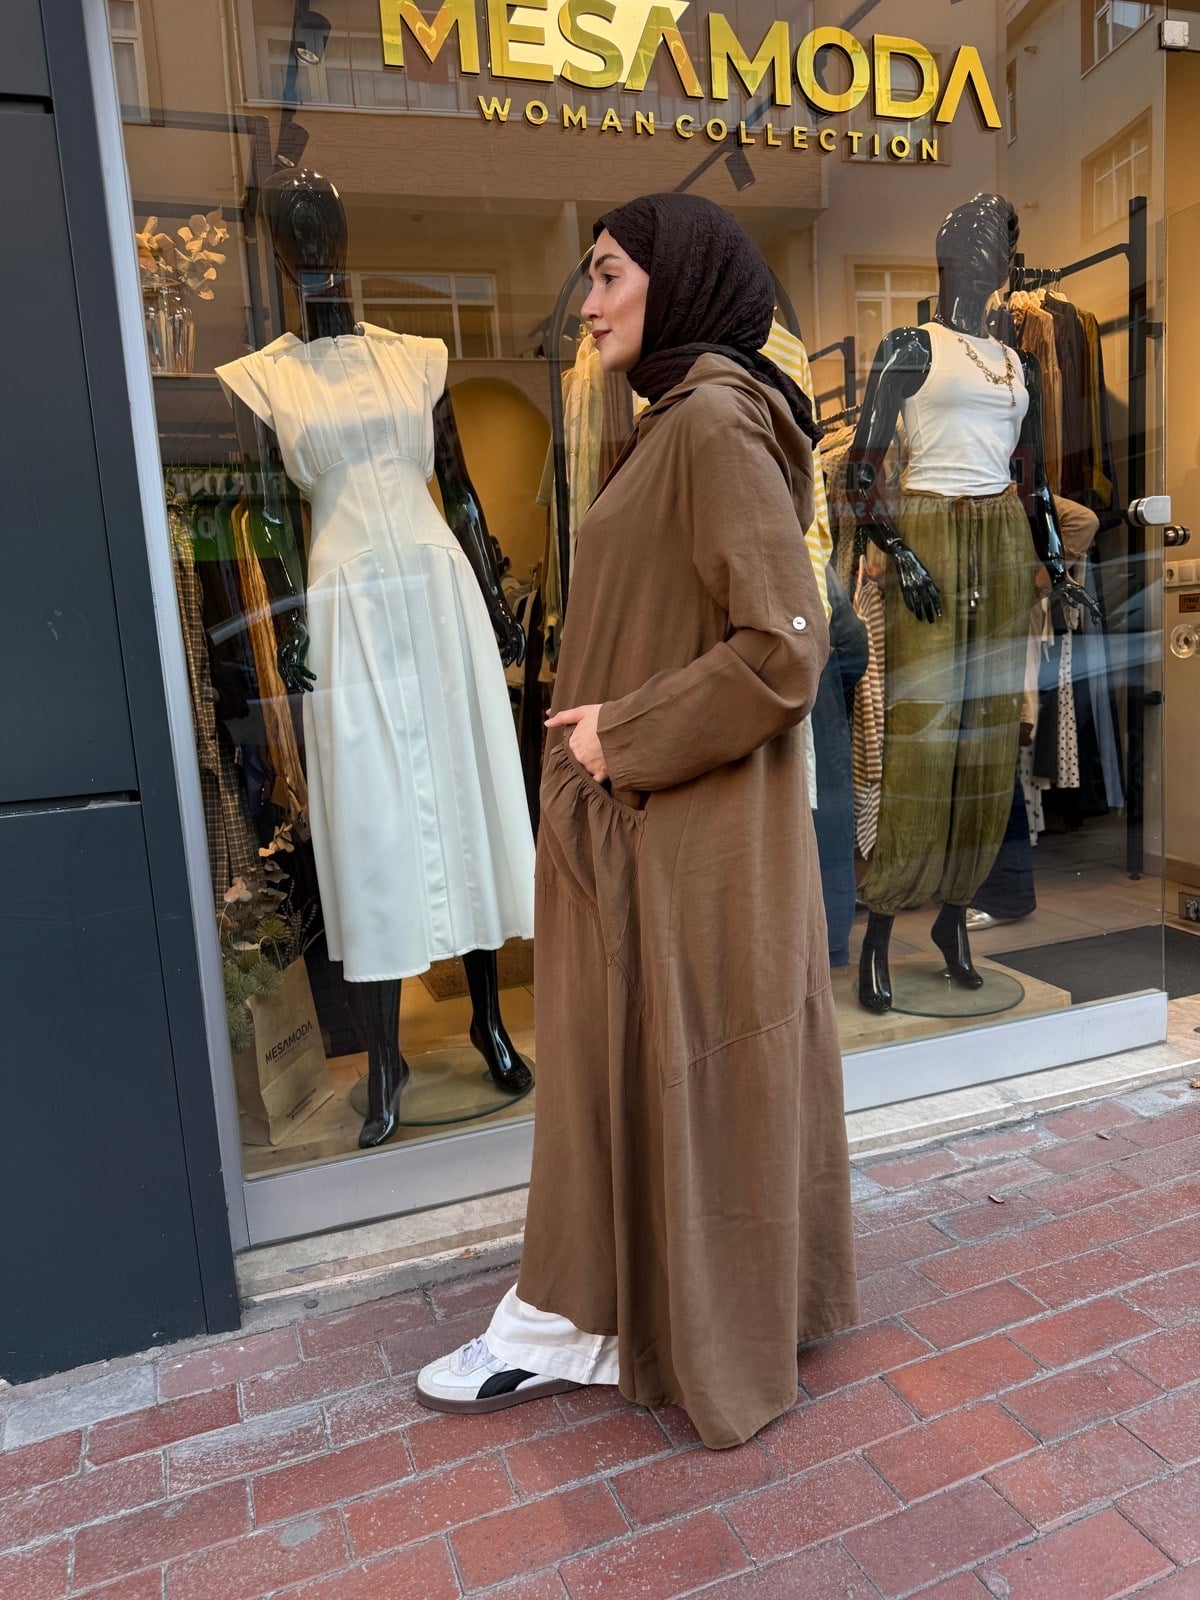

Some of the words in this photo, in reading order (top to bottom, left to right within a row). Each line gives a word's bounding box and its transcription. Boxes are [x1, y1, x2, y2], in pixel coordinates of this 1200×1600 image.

[379, 0, 1002, 128] MESAMODA
[477, 95, 655, 135] WOMAN
[674, 114, 939, 161] COLLECTION
[265, 1020, 313, 1065] MESAMODA
